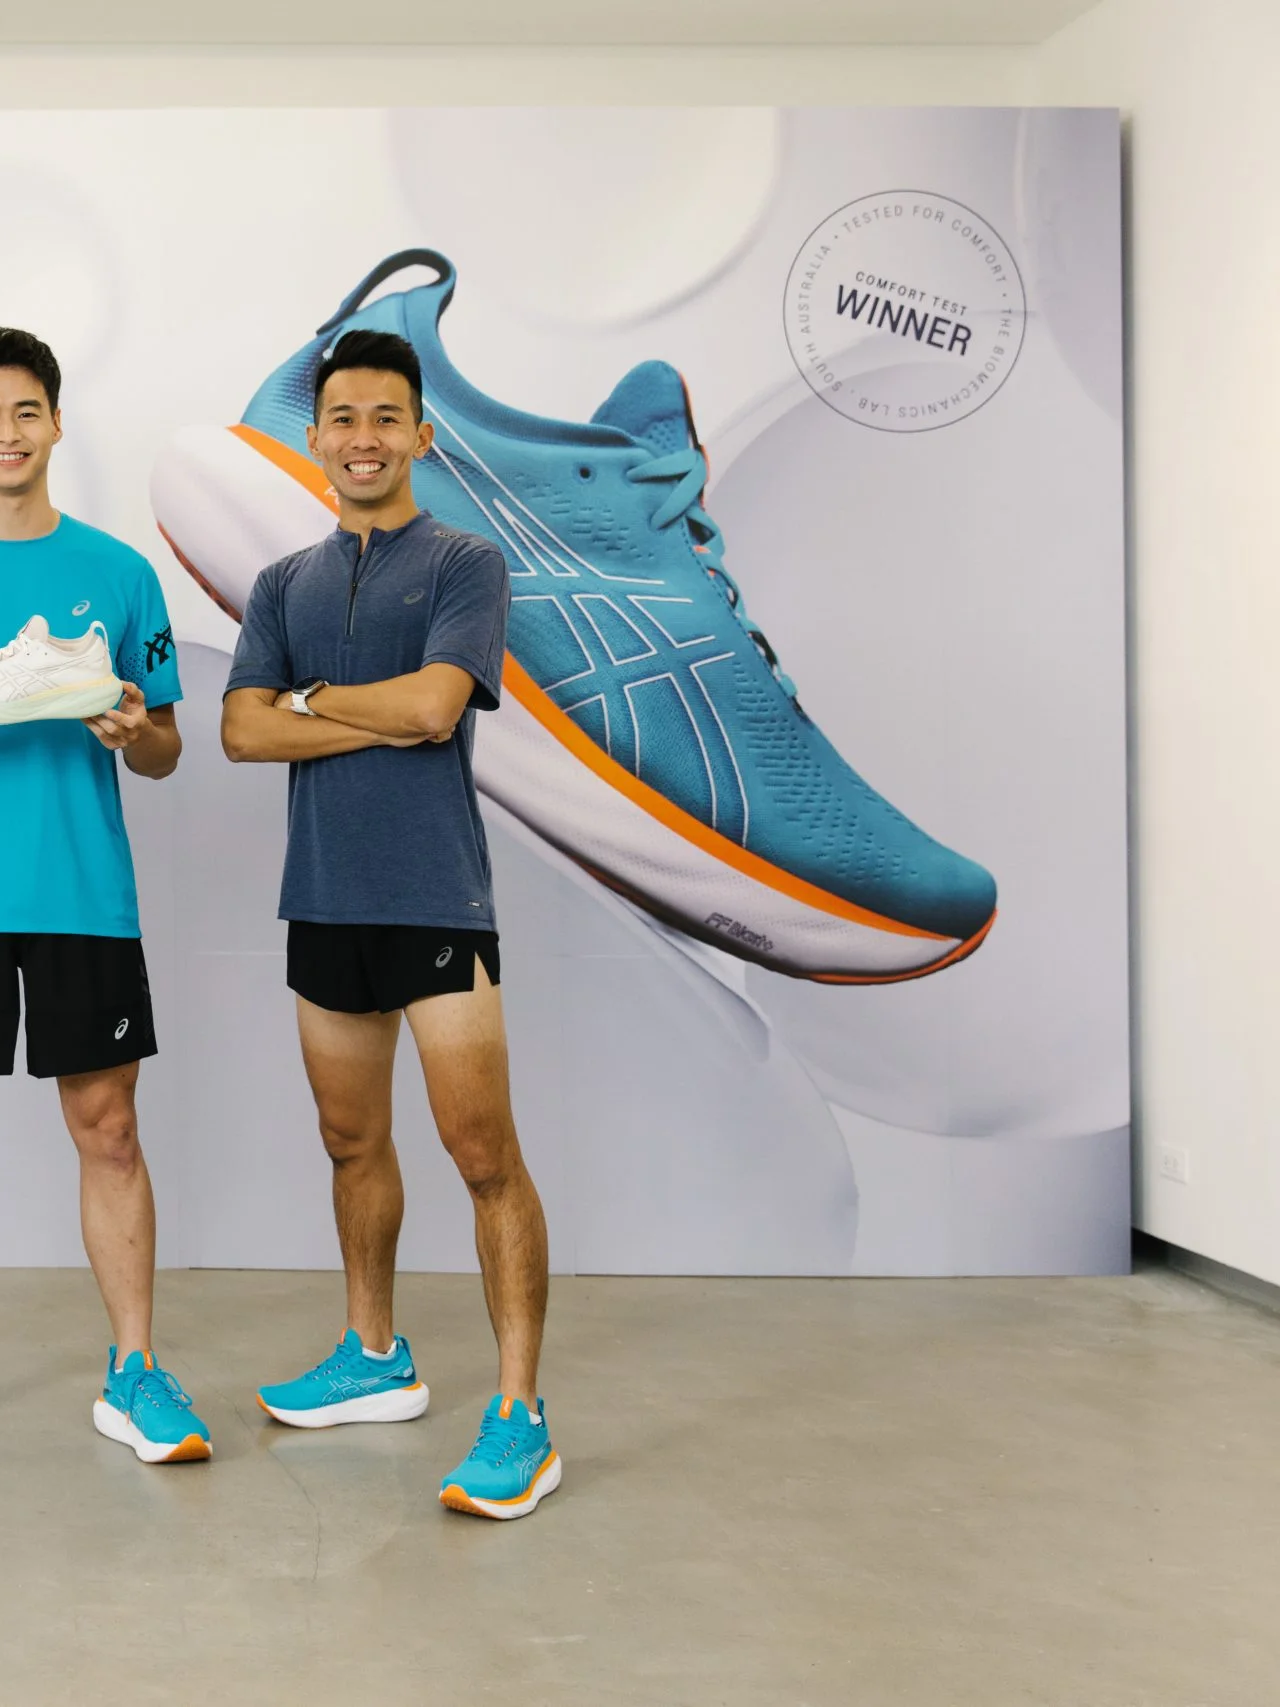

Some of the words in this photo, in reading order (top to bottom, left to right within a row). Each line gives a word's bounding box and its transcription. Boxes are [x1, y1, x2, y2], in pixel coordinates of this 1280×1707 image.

[841, 204, 904, 234] TESTED
[912, 205, 945, 224] FOR
[951, 218, 1008, 284] COMFORT
[797, 244, 832, 334] AUSTRALIA
[855, 271, 927, 303] COMFORT
[932, 296, 968, 316] TEST
[835, 284, 973, 357] WINNER
[998, 307, 1013, 338] THE
[805, 342, 843, 393] SOUTH
[897, 345, 1006, 418] BIOMECHANICS
[858, 397, 890, 416] LAB
